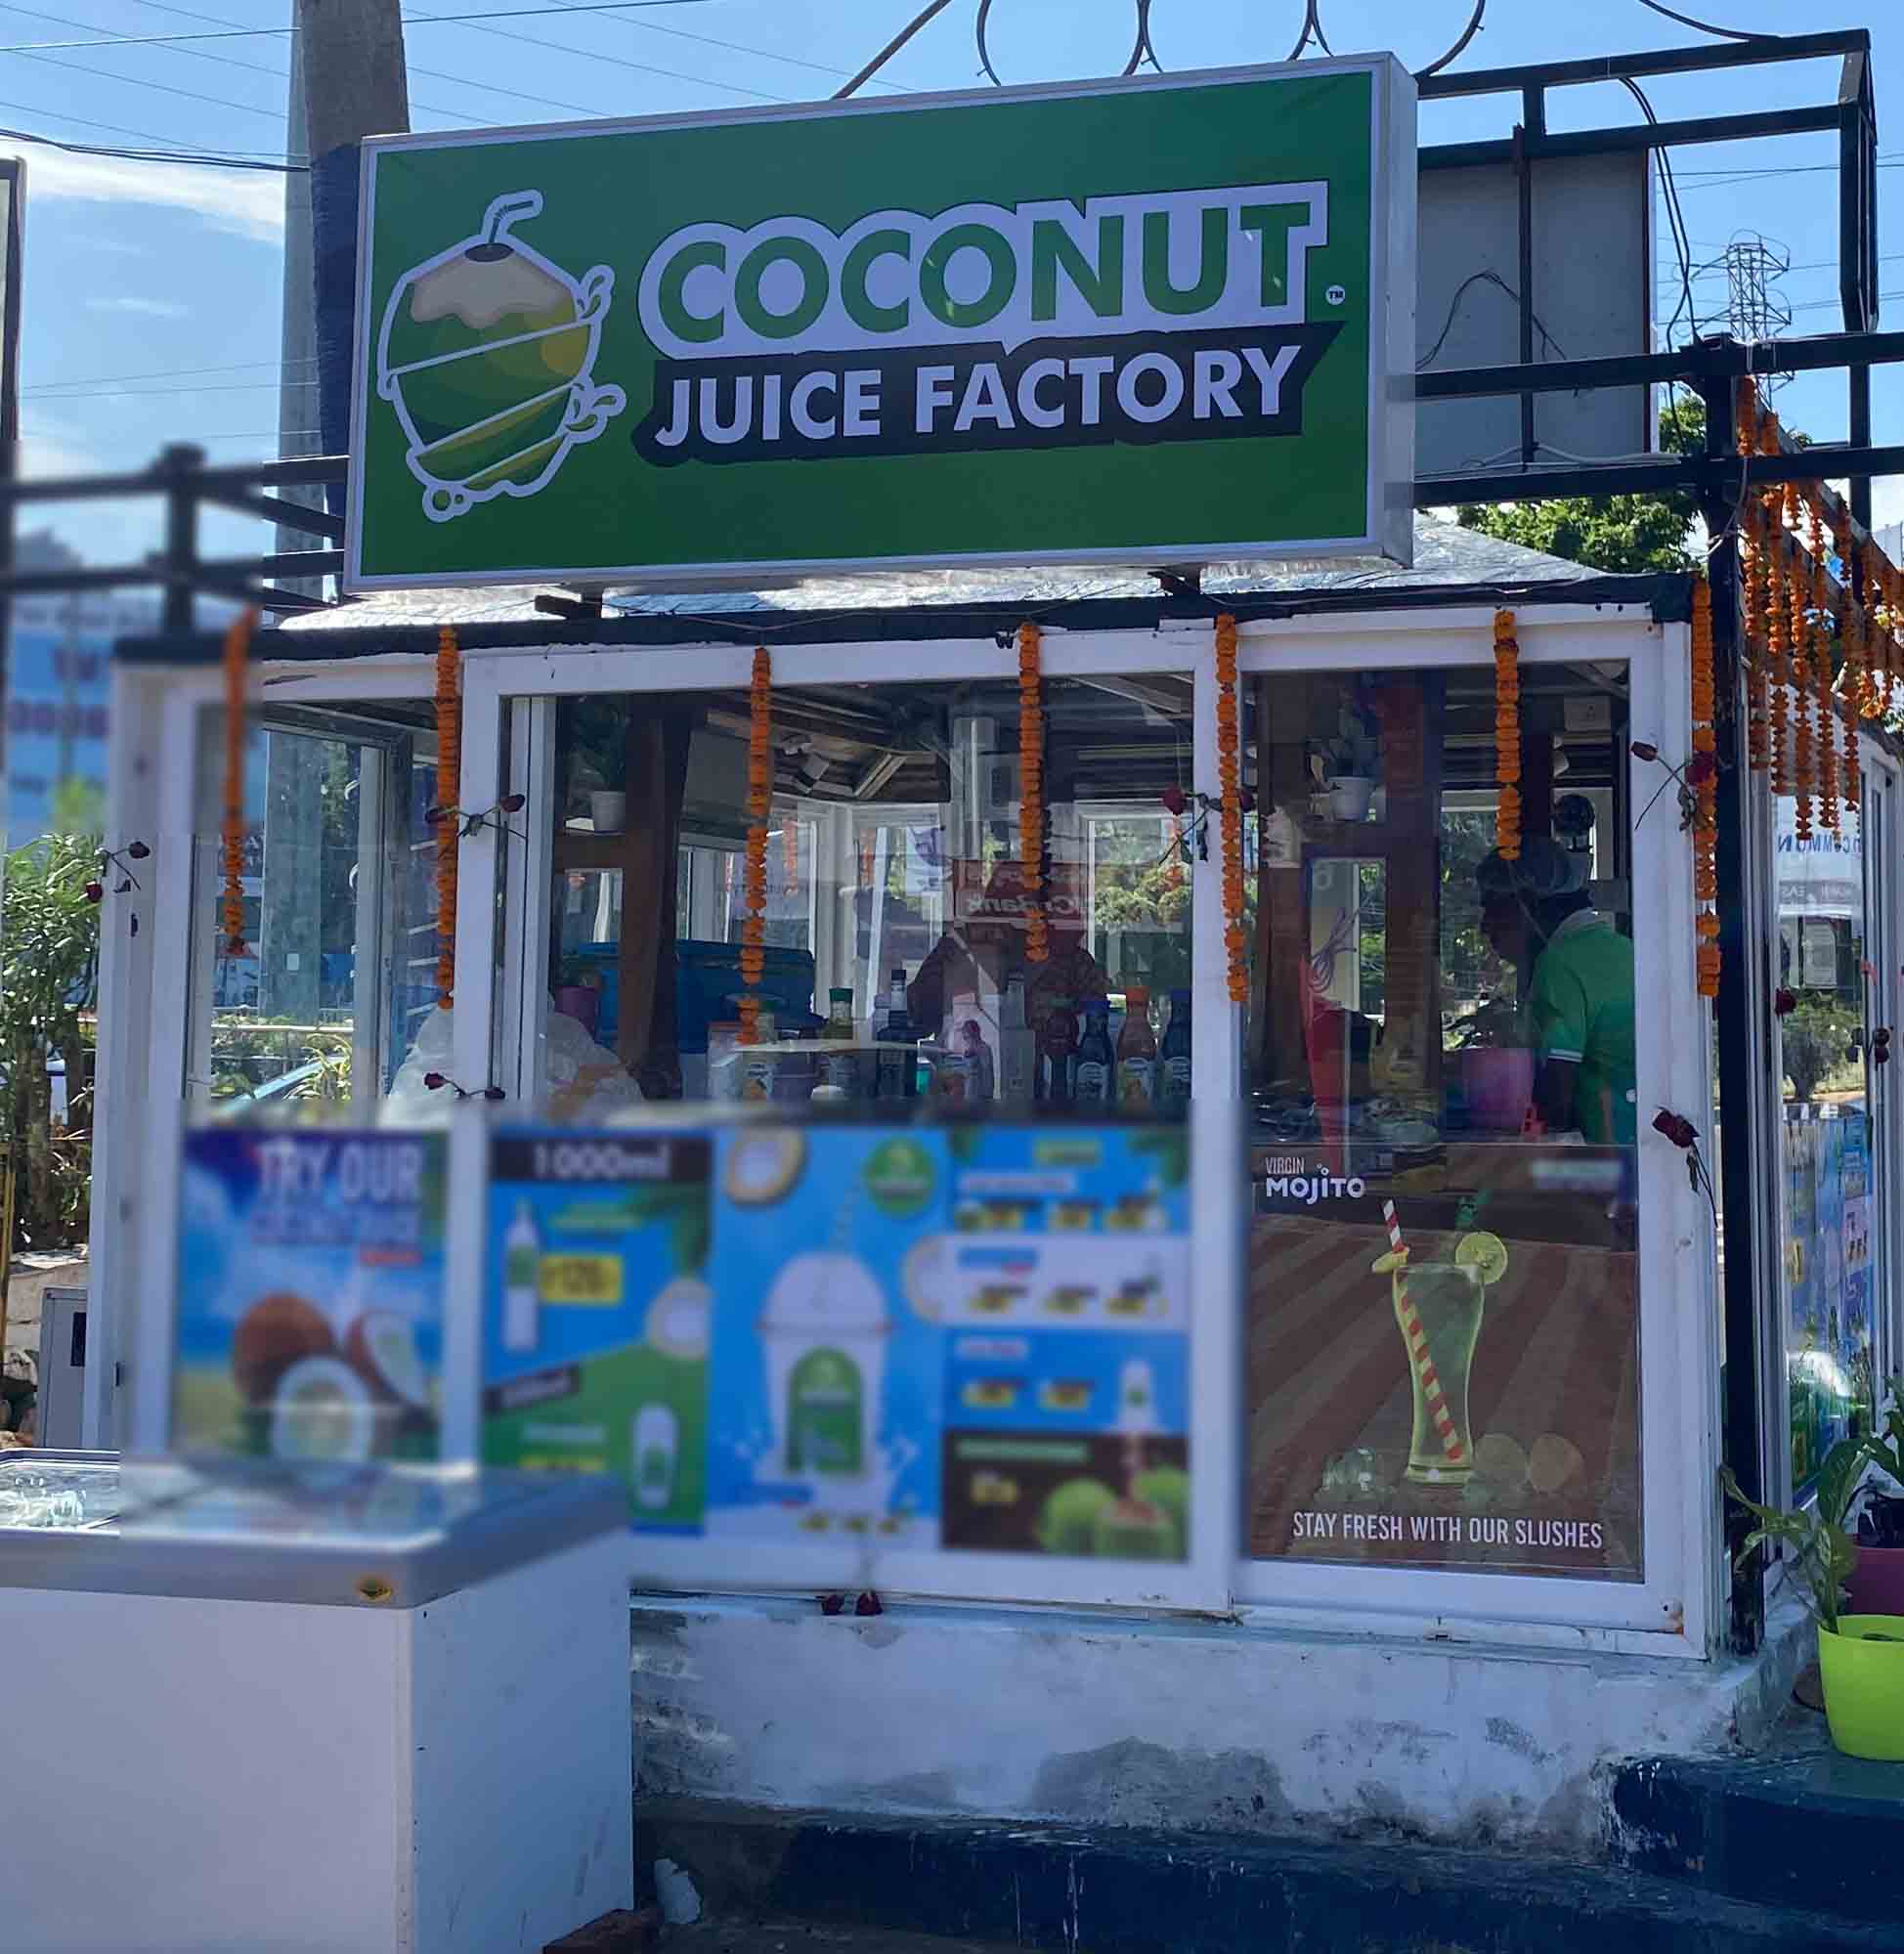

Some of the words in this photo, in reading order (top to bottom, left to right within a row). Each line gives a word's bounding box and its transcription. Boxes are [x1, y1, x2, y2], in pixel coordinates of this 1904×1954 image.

[658, 201, 1311, 343] COCONUT
[655, 369, 882, 447] JUICE
[915, 345, 1302, 434] FACTORY
[1266, 1157, 1305, 1174] VIRGIN
[1293, 1511, 1338, 1539] STAY
[1343, 1513, 1404, 1541] FRESH
[1409, 1516, 1461, 1541] WITH
[1469, 1517, 1509, 1544] OUR
[1515, 1518, 1603, 1549] SLUSHES
